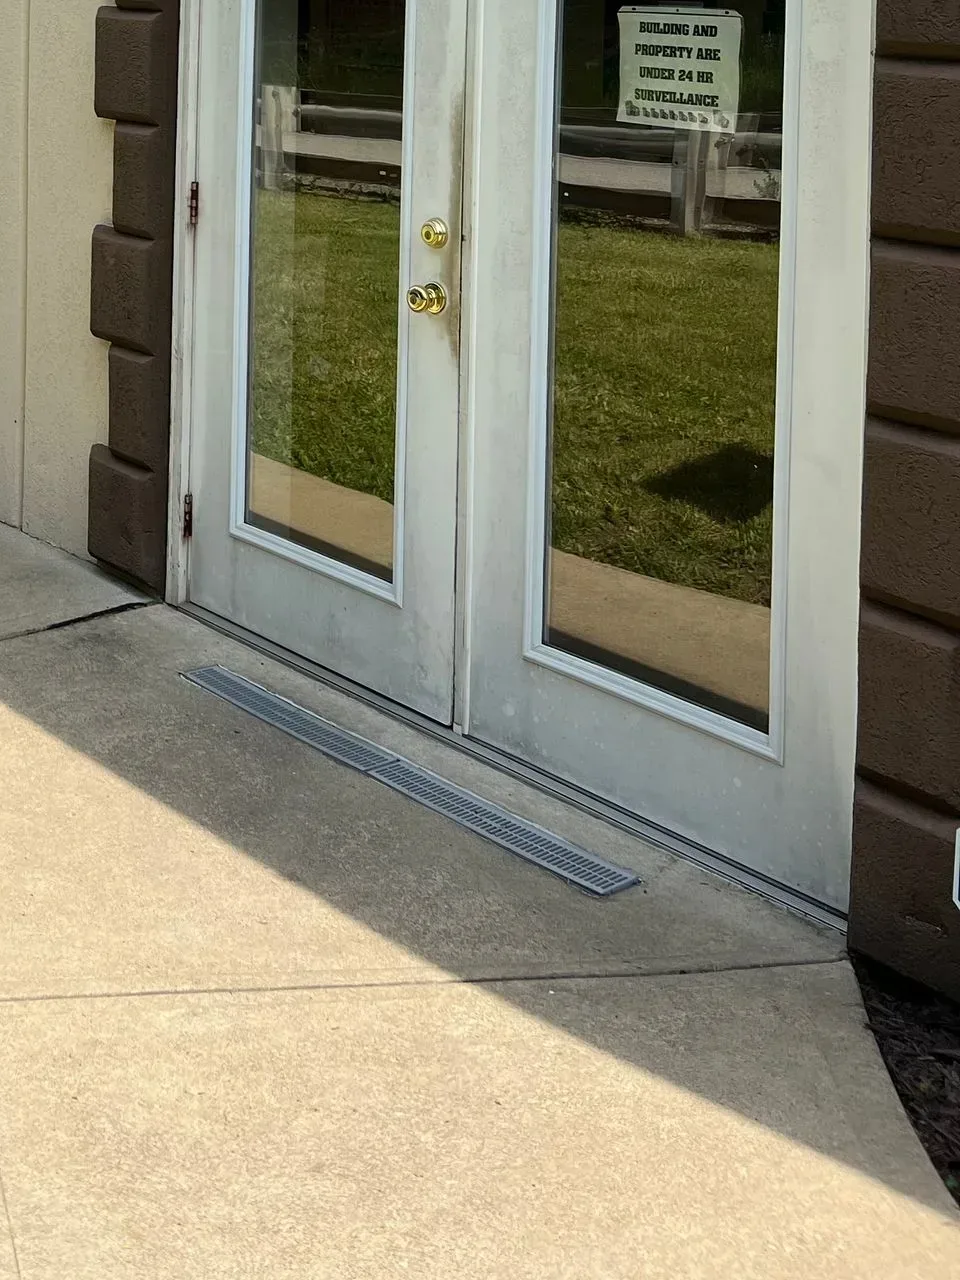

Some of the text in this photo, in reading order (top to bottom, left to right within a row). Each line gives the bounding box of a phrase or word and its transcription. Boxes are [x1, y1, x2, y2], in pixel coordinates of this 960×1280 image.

[639, 21, 718, 38] BUILDING AND
[634, 43, 721, 61] PROPERTY ARE
[639, 66, 714, 84] UNDER 24 HR
[634, 88, 719, 108] SURVEILLANCE
